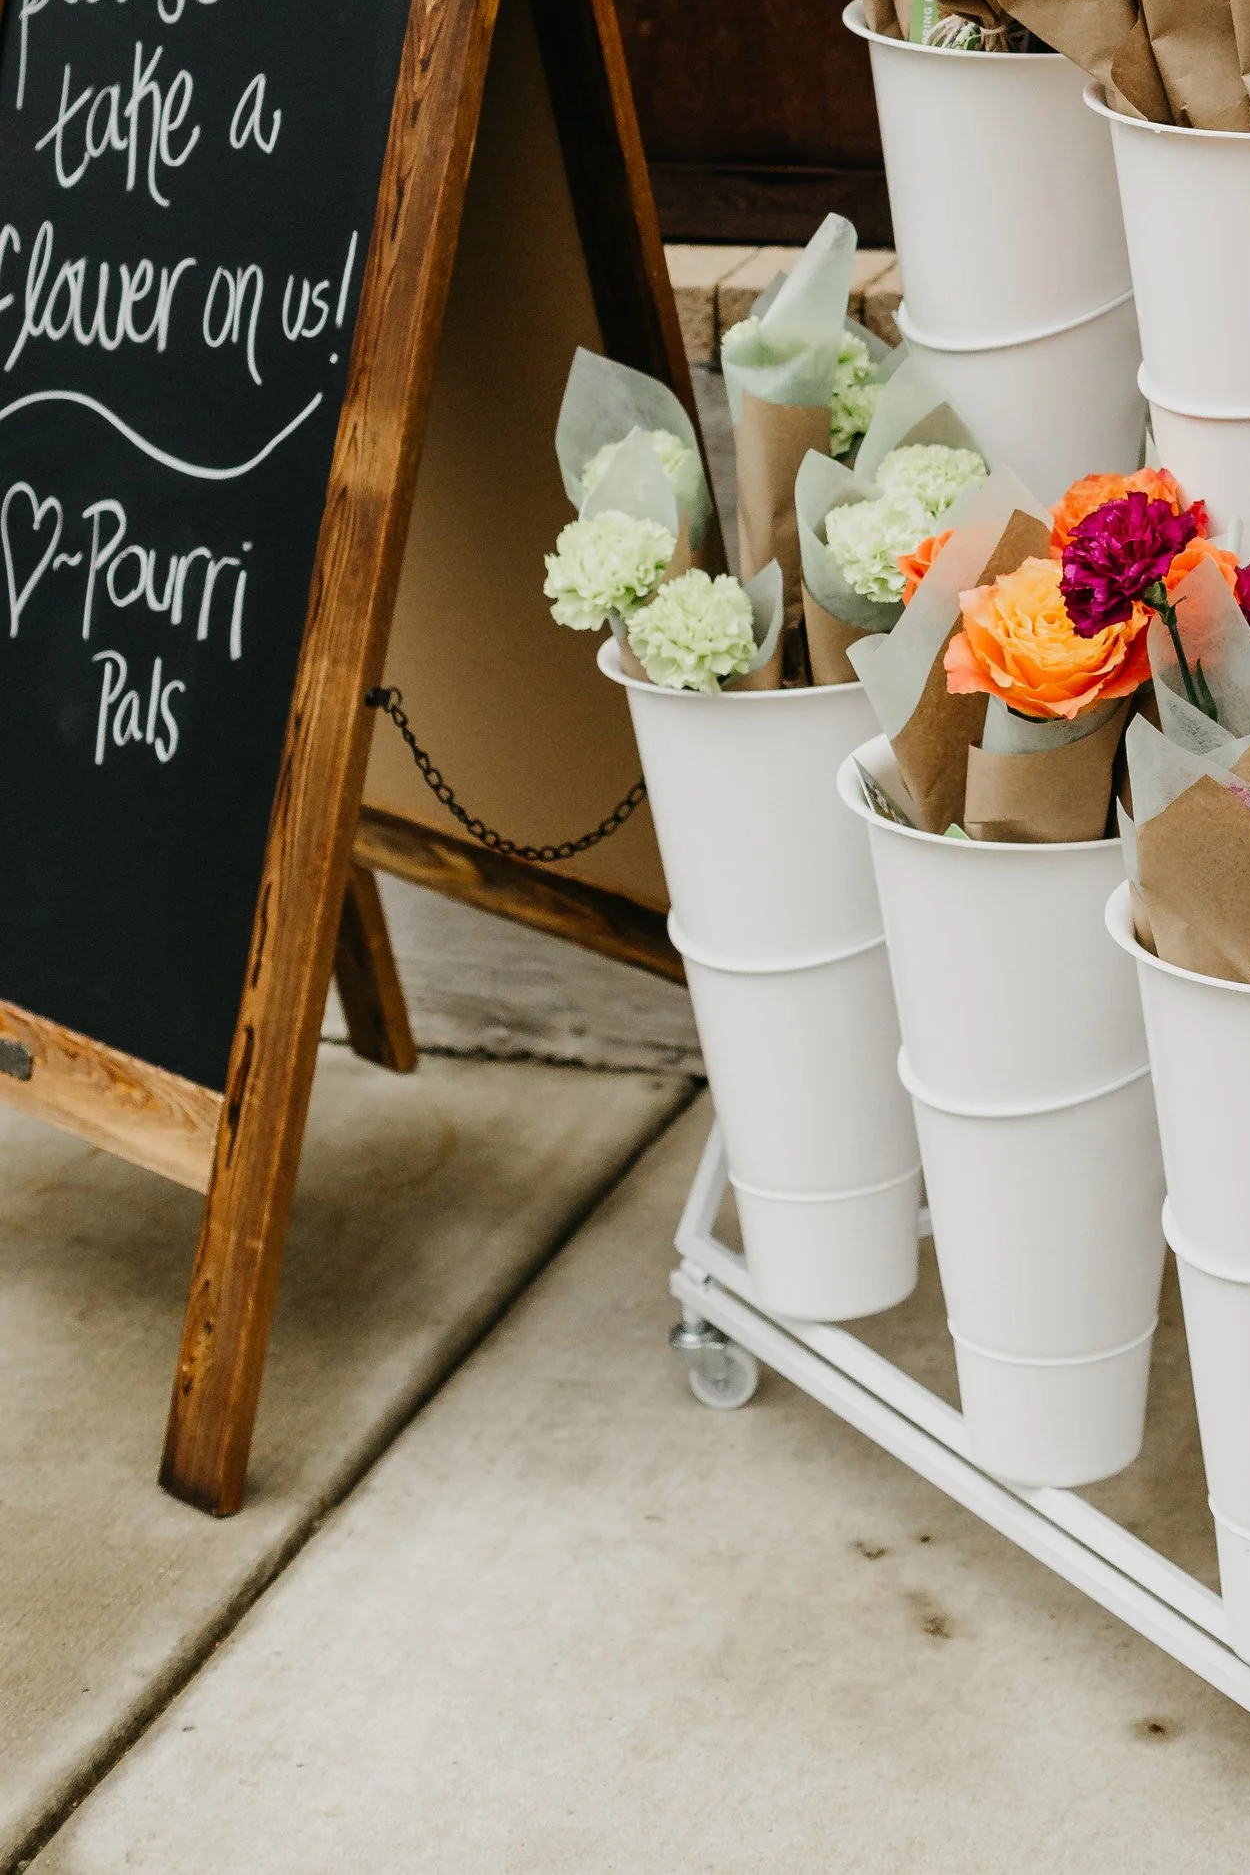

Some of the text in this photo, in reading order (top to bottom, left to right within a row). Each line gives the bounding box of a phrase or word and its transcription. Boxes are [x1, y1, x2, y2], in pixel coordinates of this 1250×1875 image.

[35, 40, 282, 208] take a
[202, 263, 263, 386] on
[282, 230, 358, 364] us!
[92, 649, 186, 766] Pals
